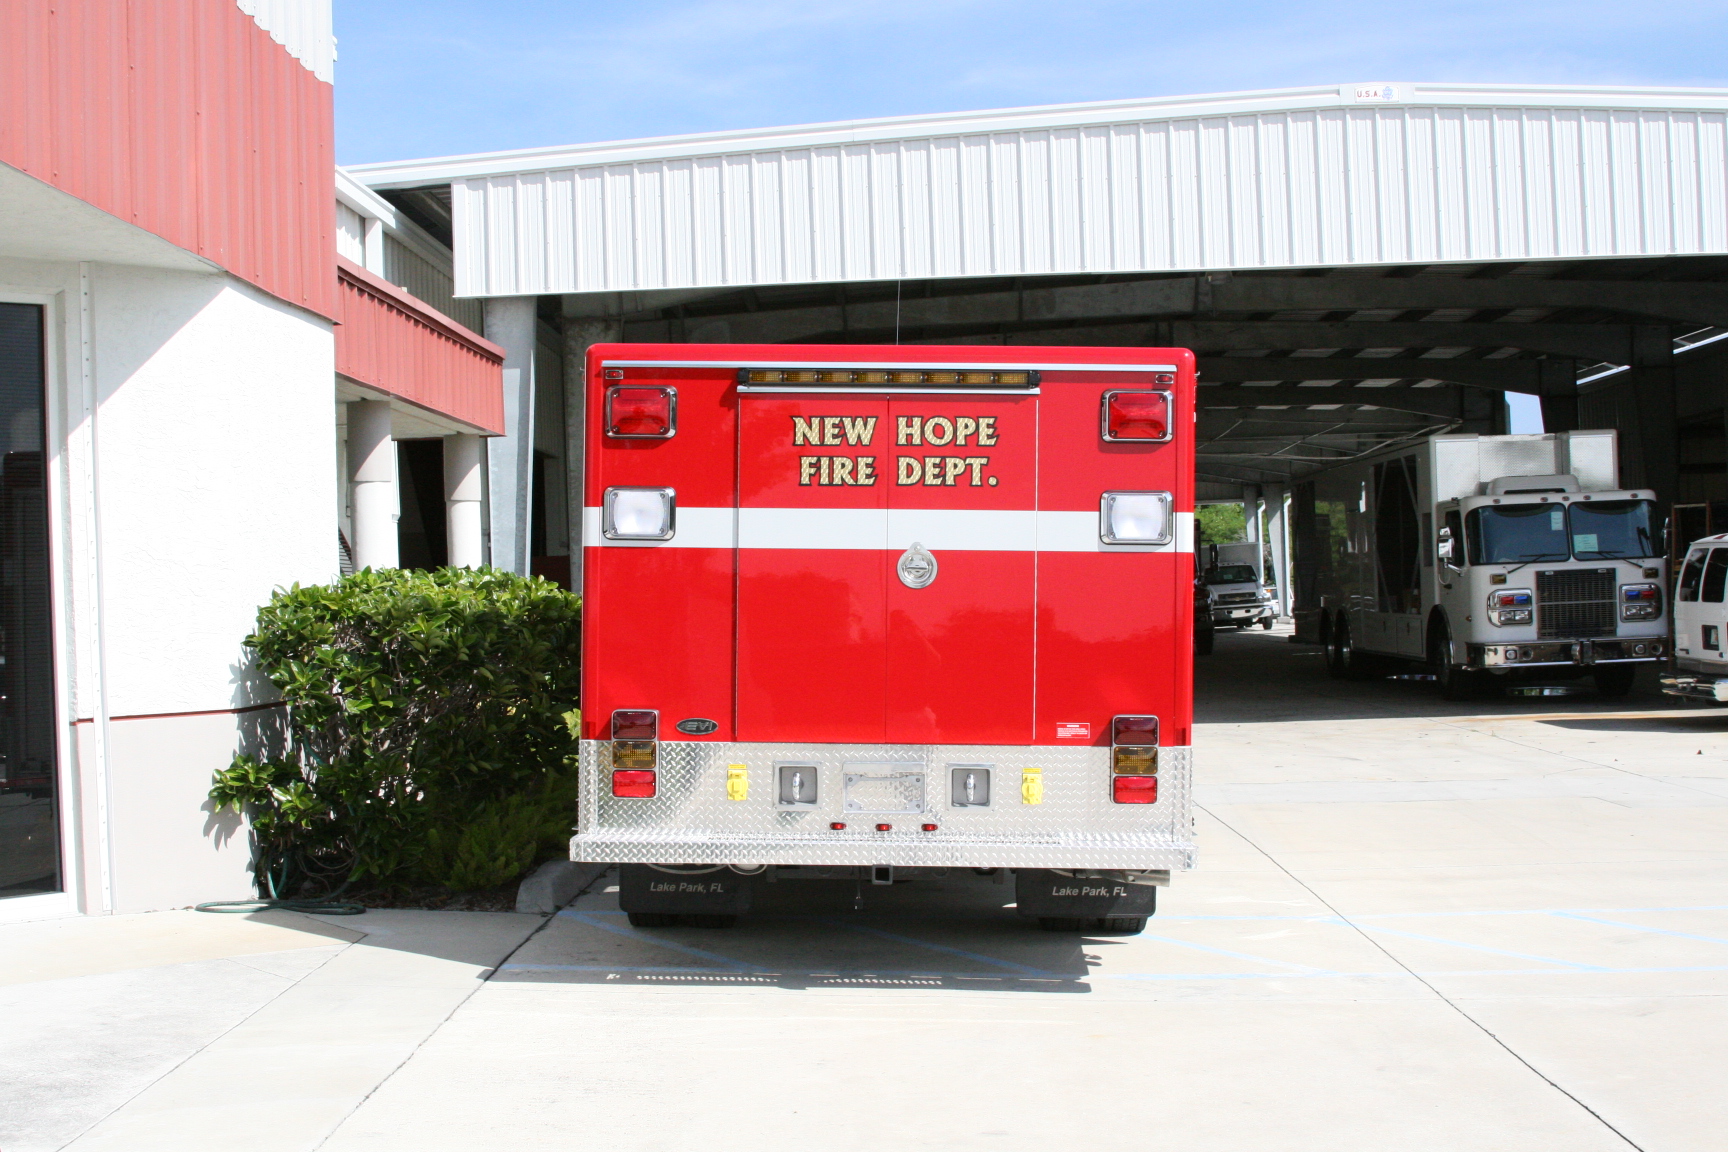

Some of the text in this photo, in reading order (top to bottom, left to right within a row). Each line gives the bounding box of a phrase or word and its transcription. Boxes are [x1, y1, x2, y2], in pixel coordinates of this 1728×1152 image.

[1356, 90, 1381, 98] U.S.A.
[791, 415, 1000, 447] NEW HOPE
[798, 456, 999, 487] FIRE DEPT.
[650, 882, 724, 894] Lake Park, FL
[1052, 886, 1127, 898] Lake Park, FL
